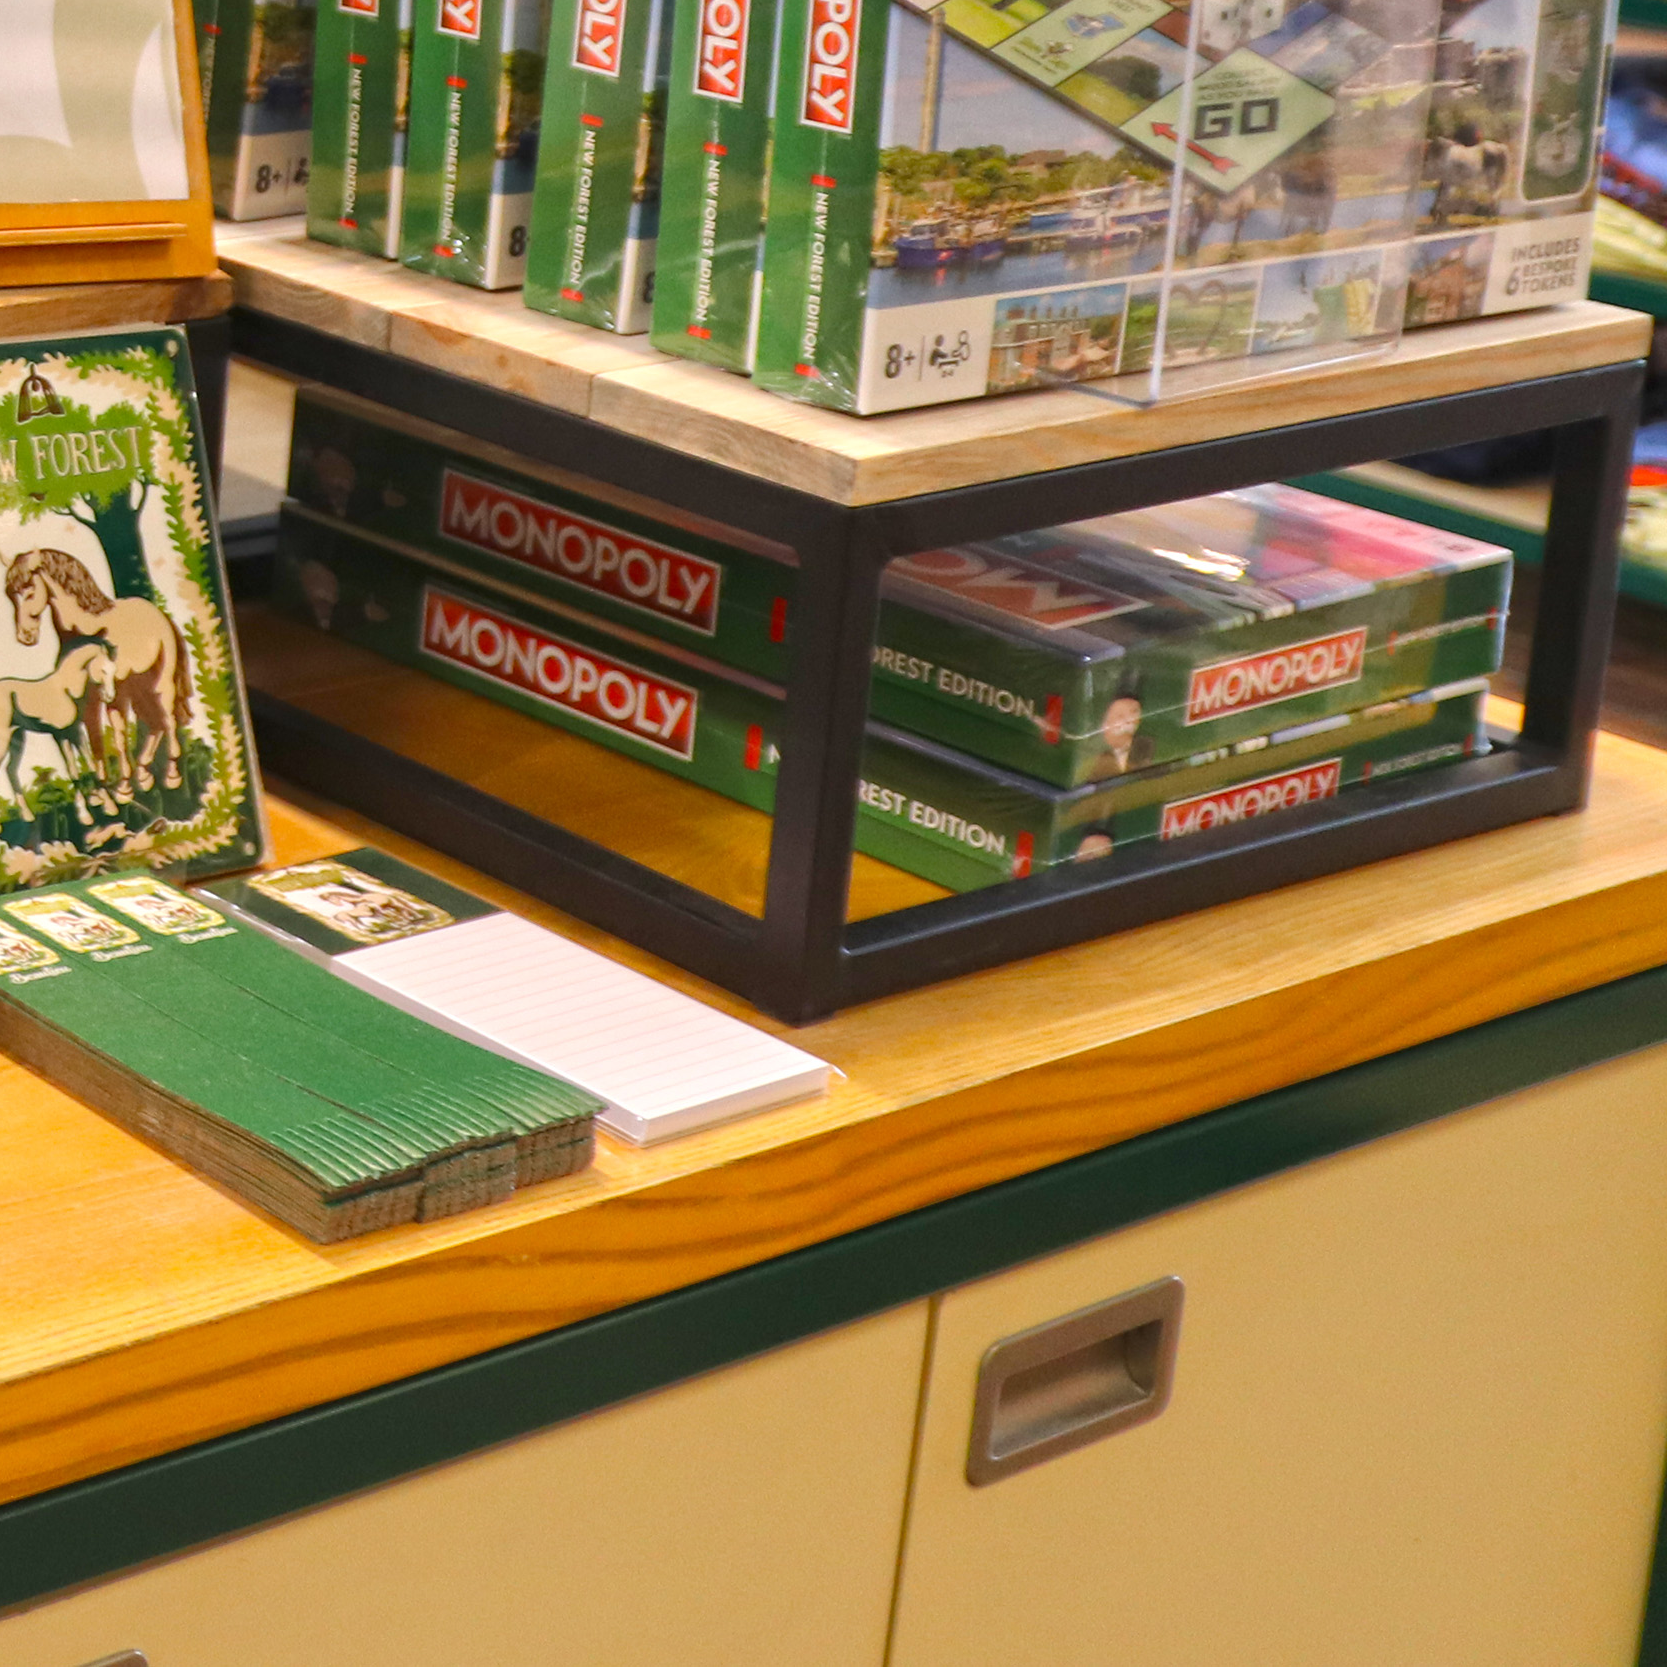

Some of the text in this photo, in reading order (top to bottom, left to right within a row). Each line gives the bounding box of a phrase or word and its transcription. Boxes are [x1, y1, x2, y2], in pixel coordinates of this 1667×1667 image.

[1194, 98, 1279, 140] GO
[803, 192, 829, 359] NEW FOREST EDITION
[31, 426, 142, 479] FOREST
[450, 486, 710, 615] MONOPOLY
[431, 600, 687, 739] MONOPOLY
[1191, 635, 1363, 715] MONOPOLY
